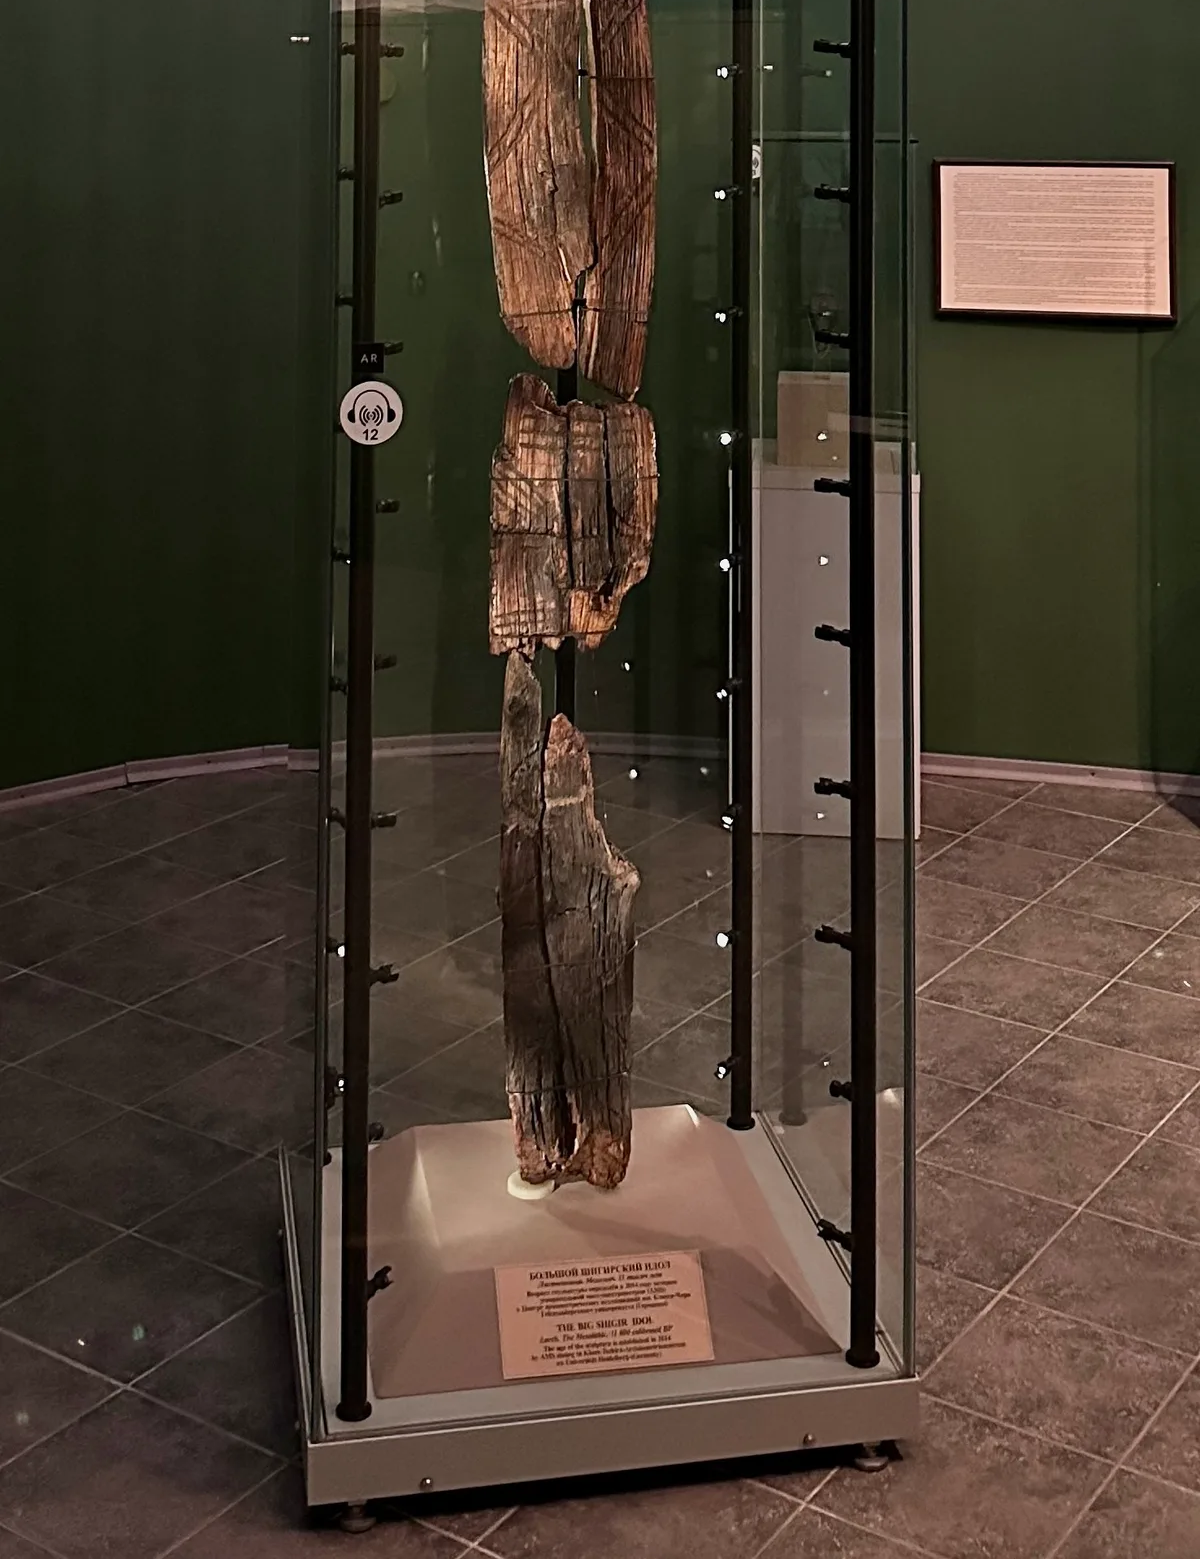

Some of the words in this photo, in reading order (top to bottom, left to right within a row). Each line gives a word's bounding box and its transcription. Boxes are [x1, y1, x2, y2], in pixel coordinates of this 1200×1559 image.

[360, 353, 378, 364] AR
[362, 428, 379, 441] 12
[529, 1268, 579, 1281] БОЛЬШОЙ
[581, 1262, 642, 1276] ШИГИРСКИЙ
[557, 1323, 575, 1332] THE
[578, 1321, 594, 1331] BIG
[596, 1318, 629, 1329] SHIGIR
[632, 1315, 655, 1326] IDOL
